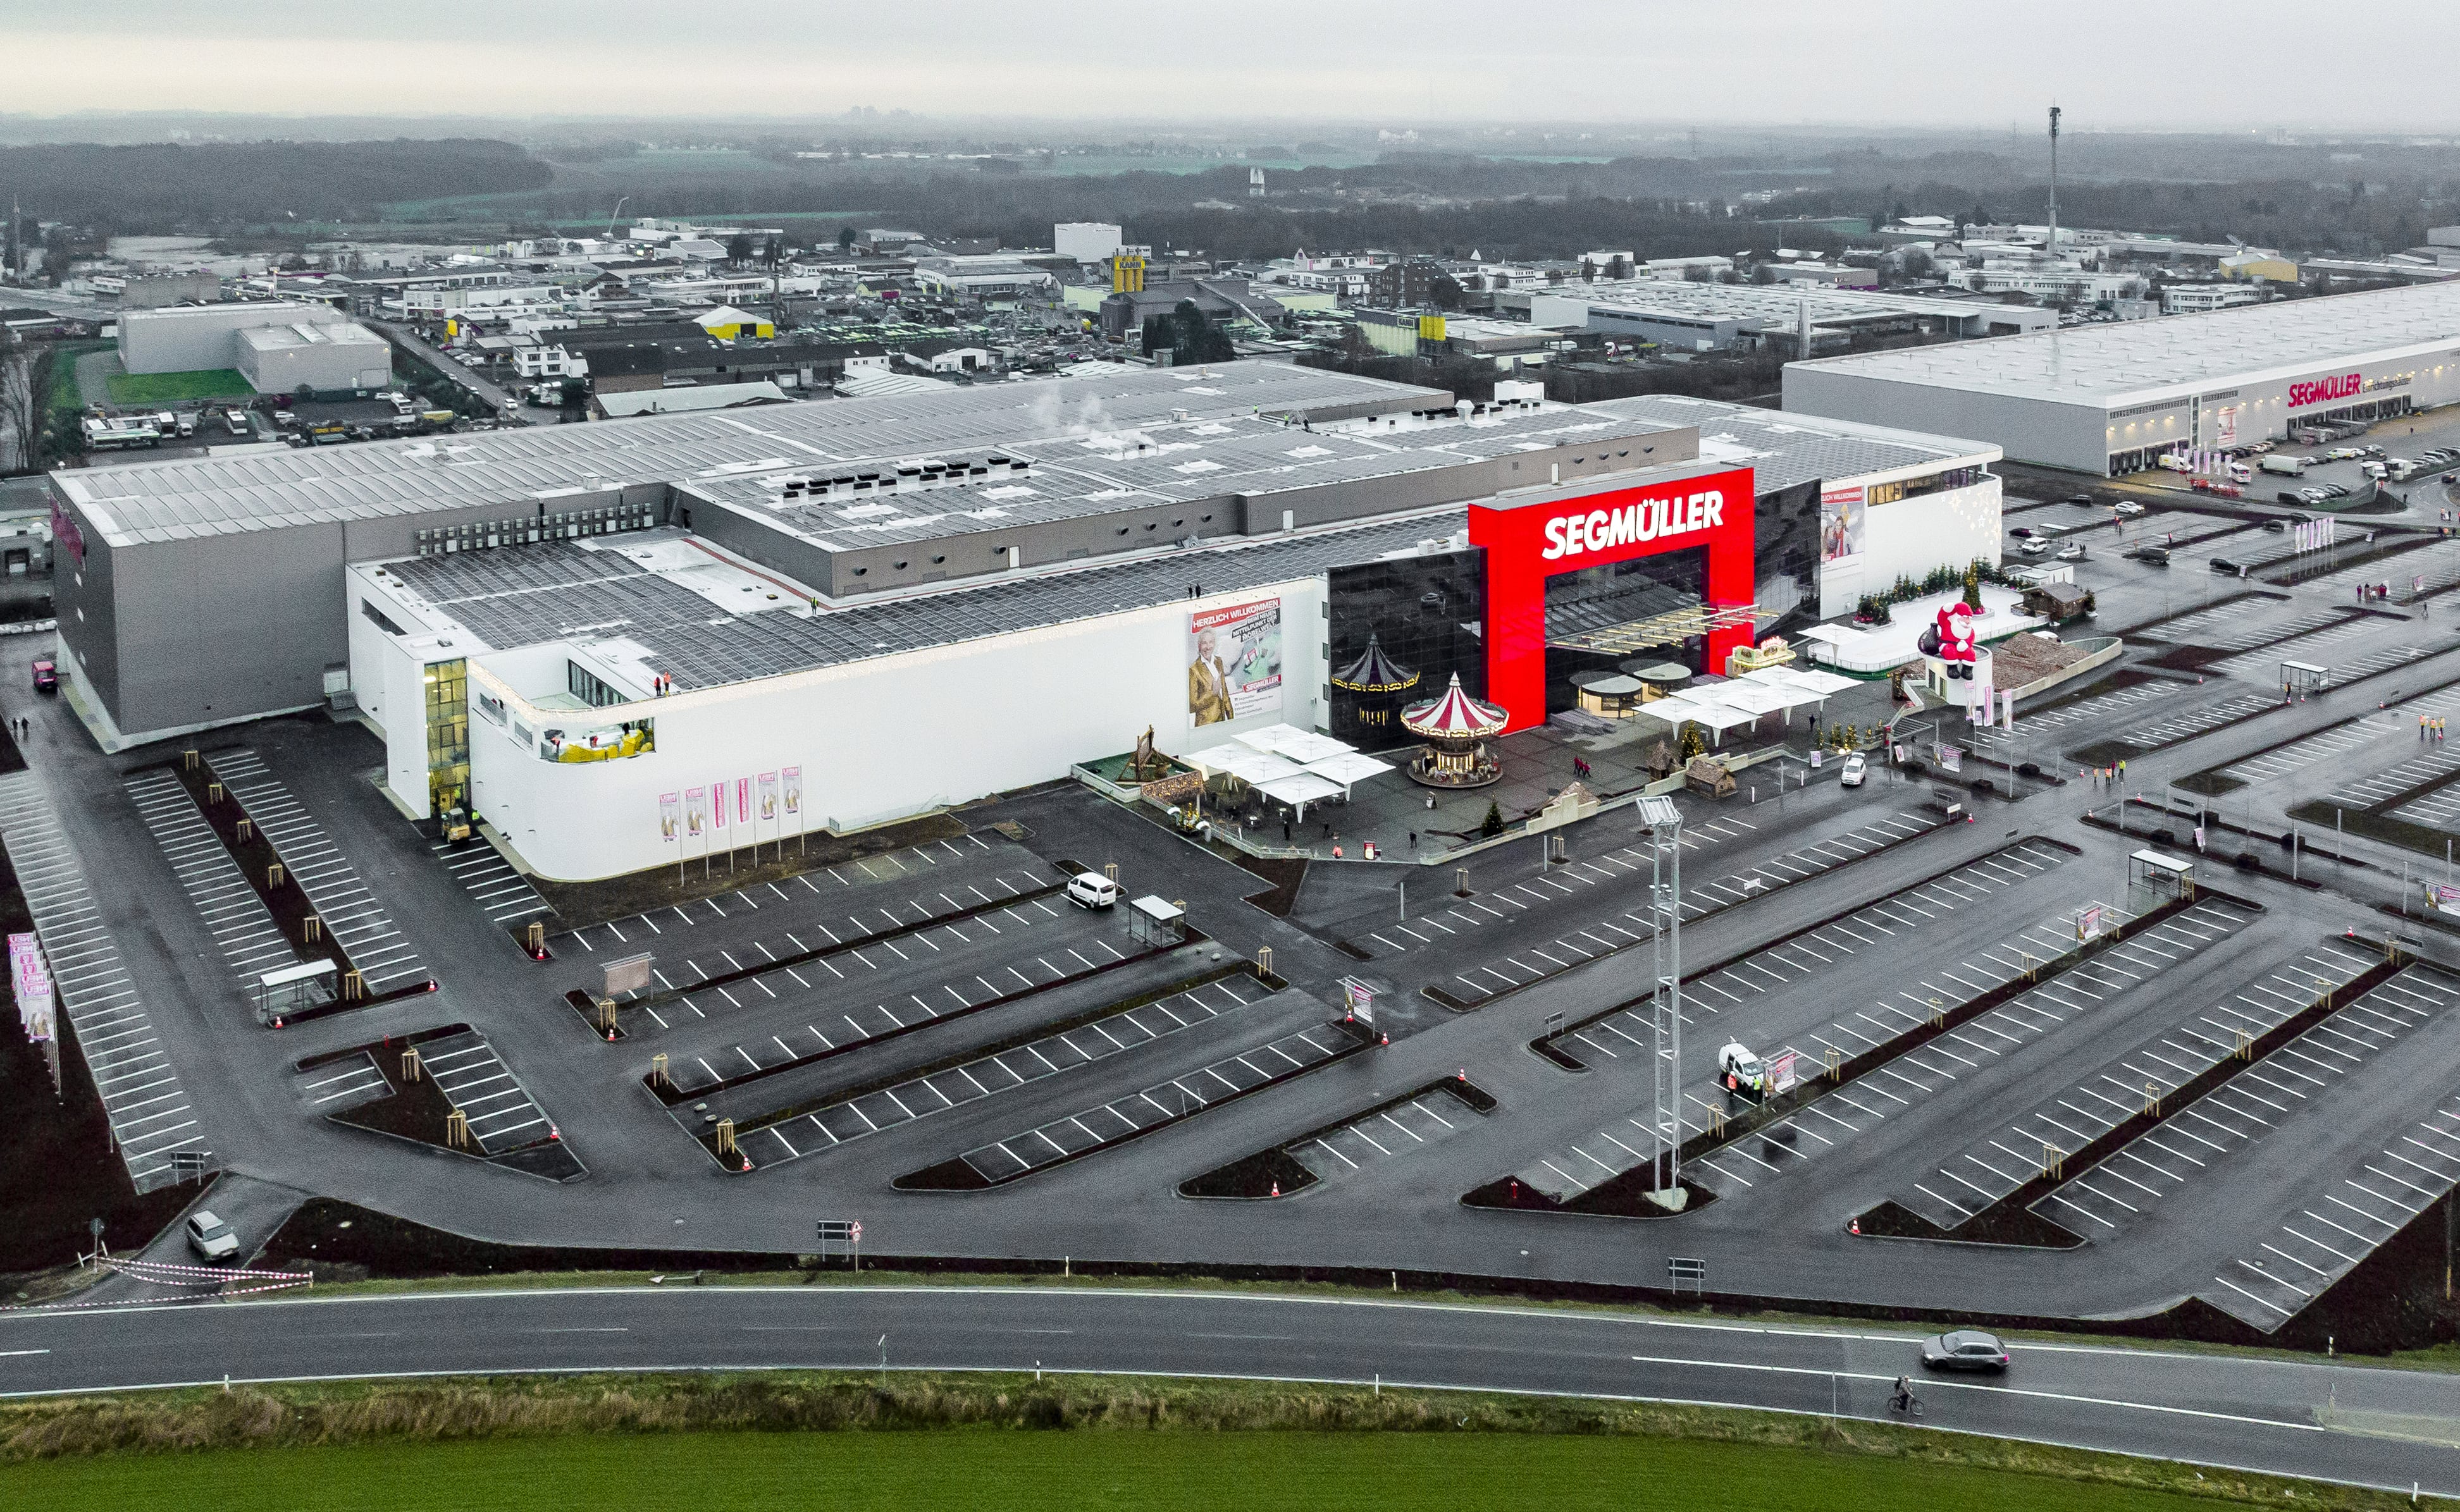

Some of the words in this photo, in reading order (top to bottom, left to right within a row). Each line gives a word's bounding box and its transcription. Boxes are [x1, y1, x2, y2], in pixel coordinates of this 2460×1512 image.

[2288, 373, 2361, 408] SEGMÜLLER
[1834, 491, 1862, 500] WILLKOMMEN
[1542, 490, 1724, 560] SEGMÜLLER
[1193, 613, 1229, 629] HERZLICH
[1230, 599, 1278, 619] WILLKOMMEN
[1260, 610, 1276, 620] NEUEN
[1233, 619, 1266, 637] MITTELPUNKT
[1246, 676, 1279, 691] SEGMÜLLER
